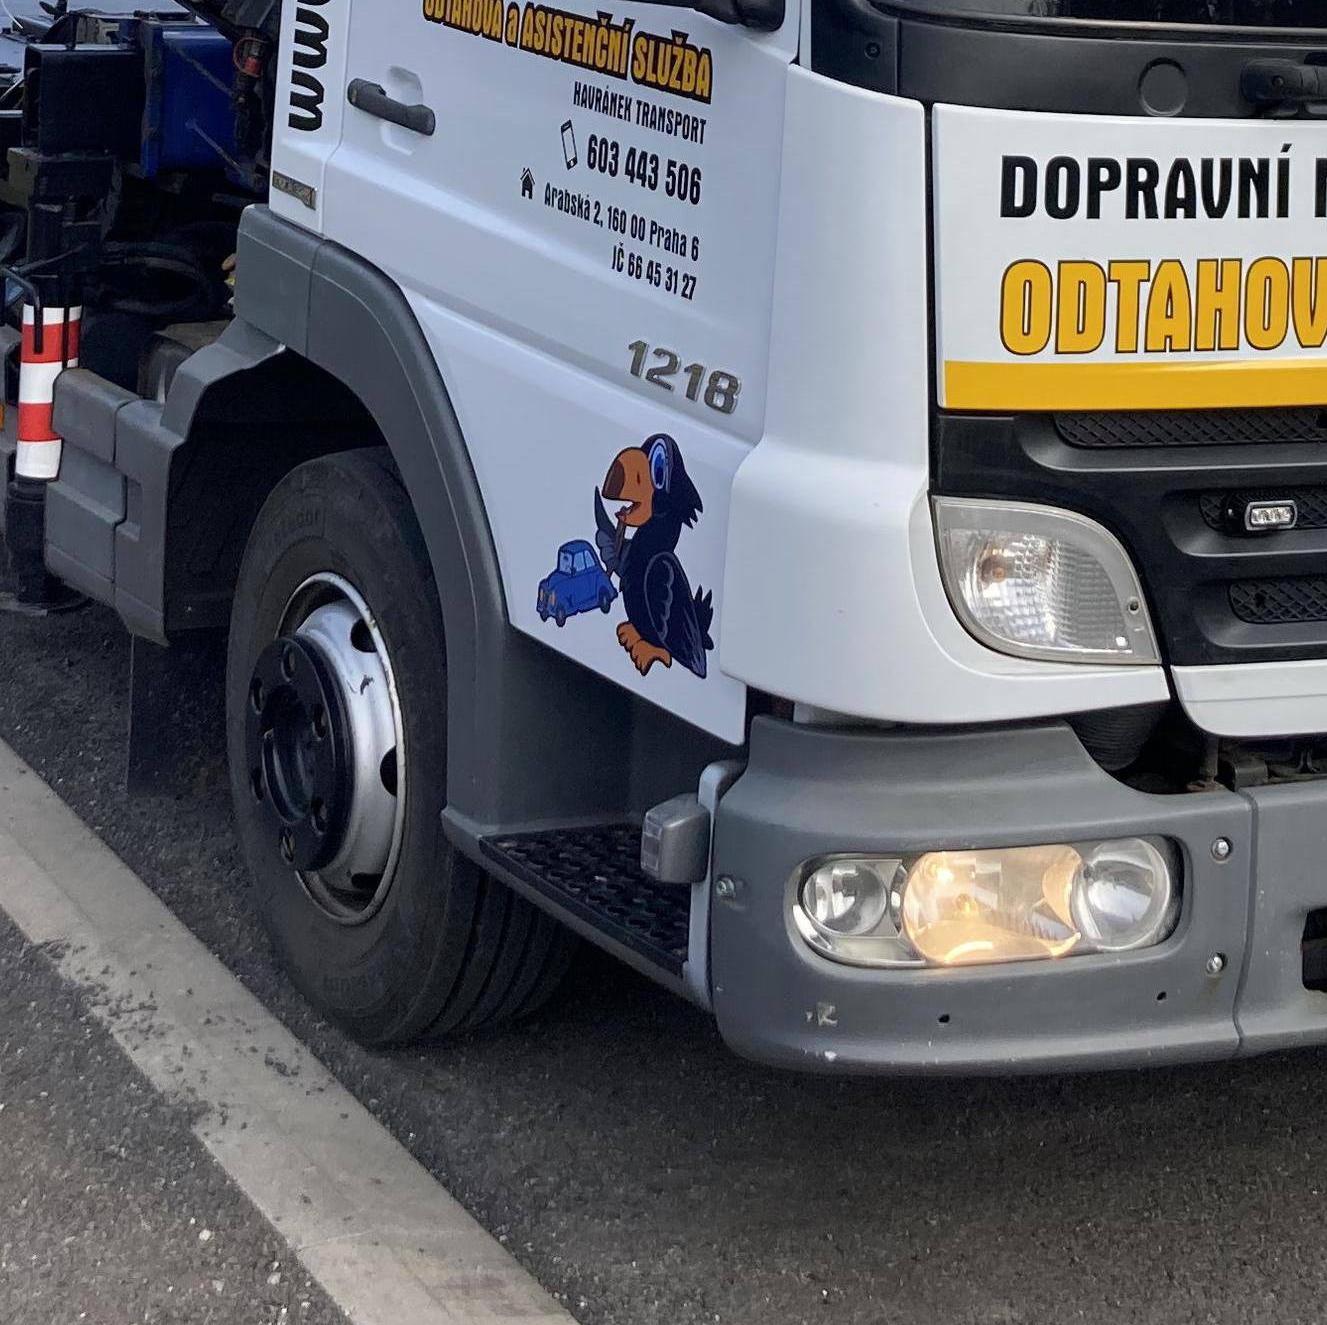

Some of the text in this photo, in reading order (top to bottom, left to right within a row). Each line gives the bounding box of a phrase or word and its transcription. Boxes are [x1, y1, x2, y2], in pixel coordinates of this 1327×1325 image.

[506, 4, 519, 45] a
[521, 4, 634, 77] ASISTENČNÍ
[632, 31, 711, 101] SLUŽBA
[573, 81, 706, 144] HAVRÁNEK TRANSPORT
[587, 134, 701, 205] 603 443 506
[1000, 143, 1292, 220] DOPRAVNÍ
[544, 182, 699, 262] Arabská 2, 160 00 Praha 6
[612, 243, 697, 301] IČ 66 45 31 27
[627, 340, 742, 415] 1218
